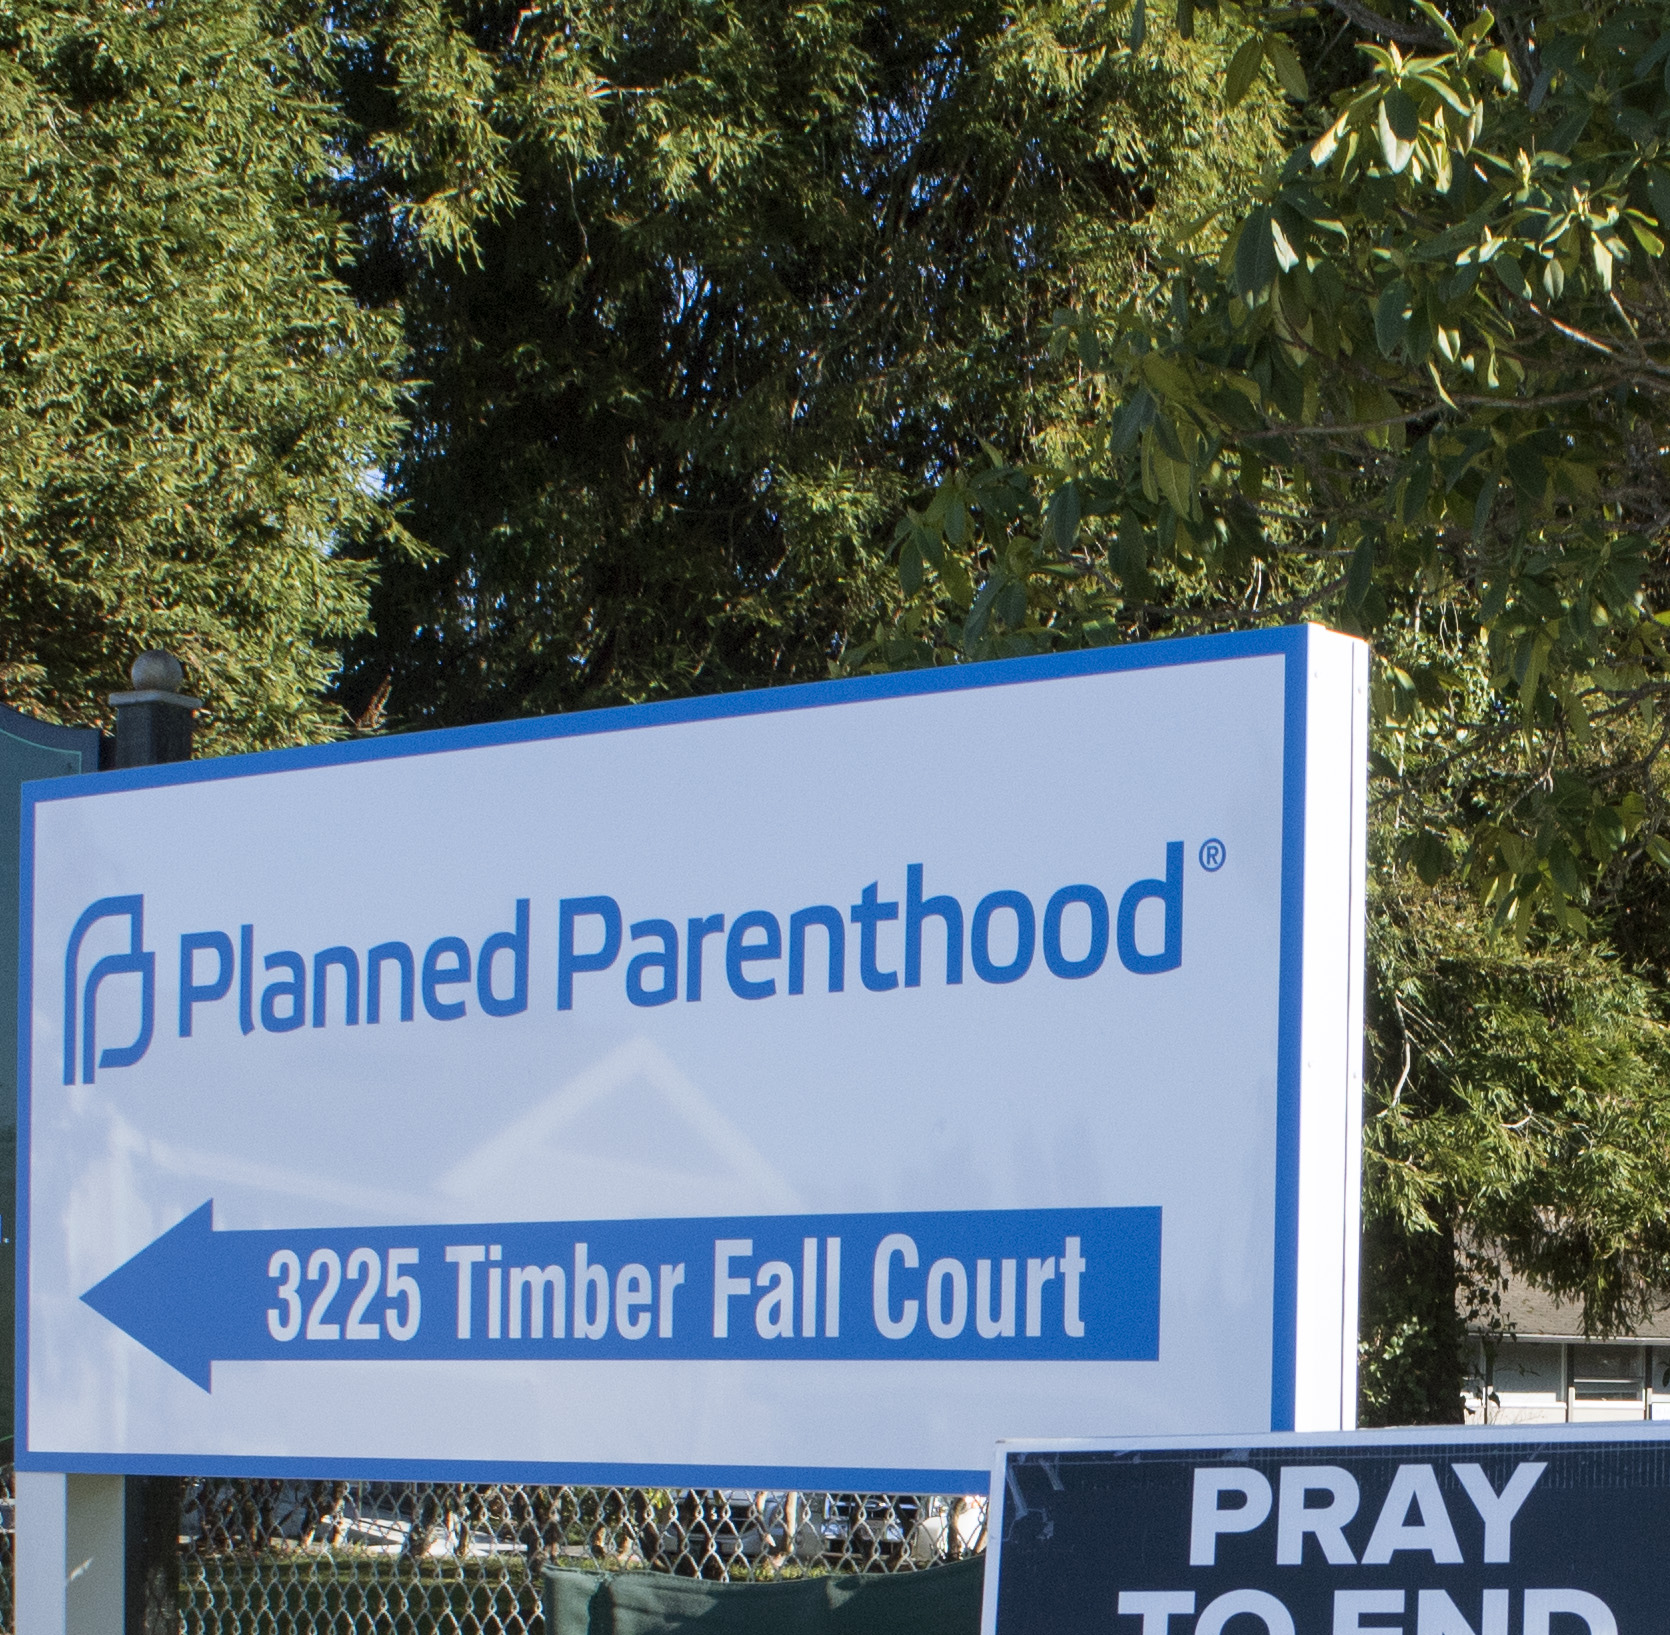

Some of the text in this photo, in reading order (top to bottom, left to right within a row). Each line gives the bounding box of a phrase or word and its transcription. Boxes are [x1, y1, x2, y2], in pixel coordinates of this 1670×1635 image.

[178, 898, 530, 1039] Planned
[556, 840, 1186, 1011] Parenthood
[266, 1233, 1087, 1342] 3225 Timber Fall Court
[1188, 1461, 1549, 1566] PRAY
